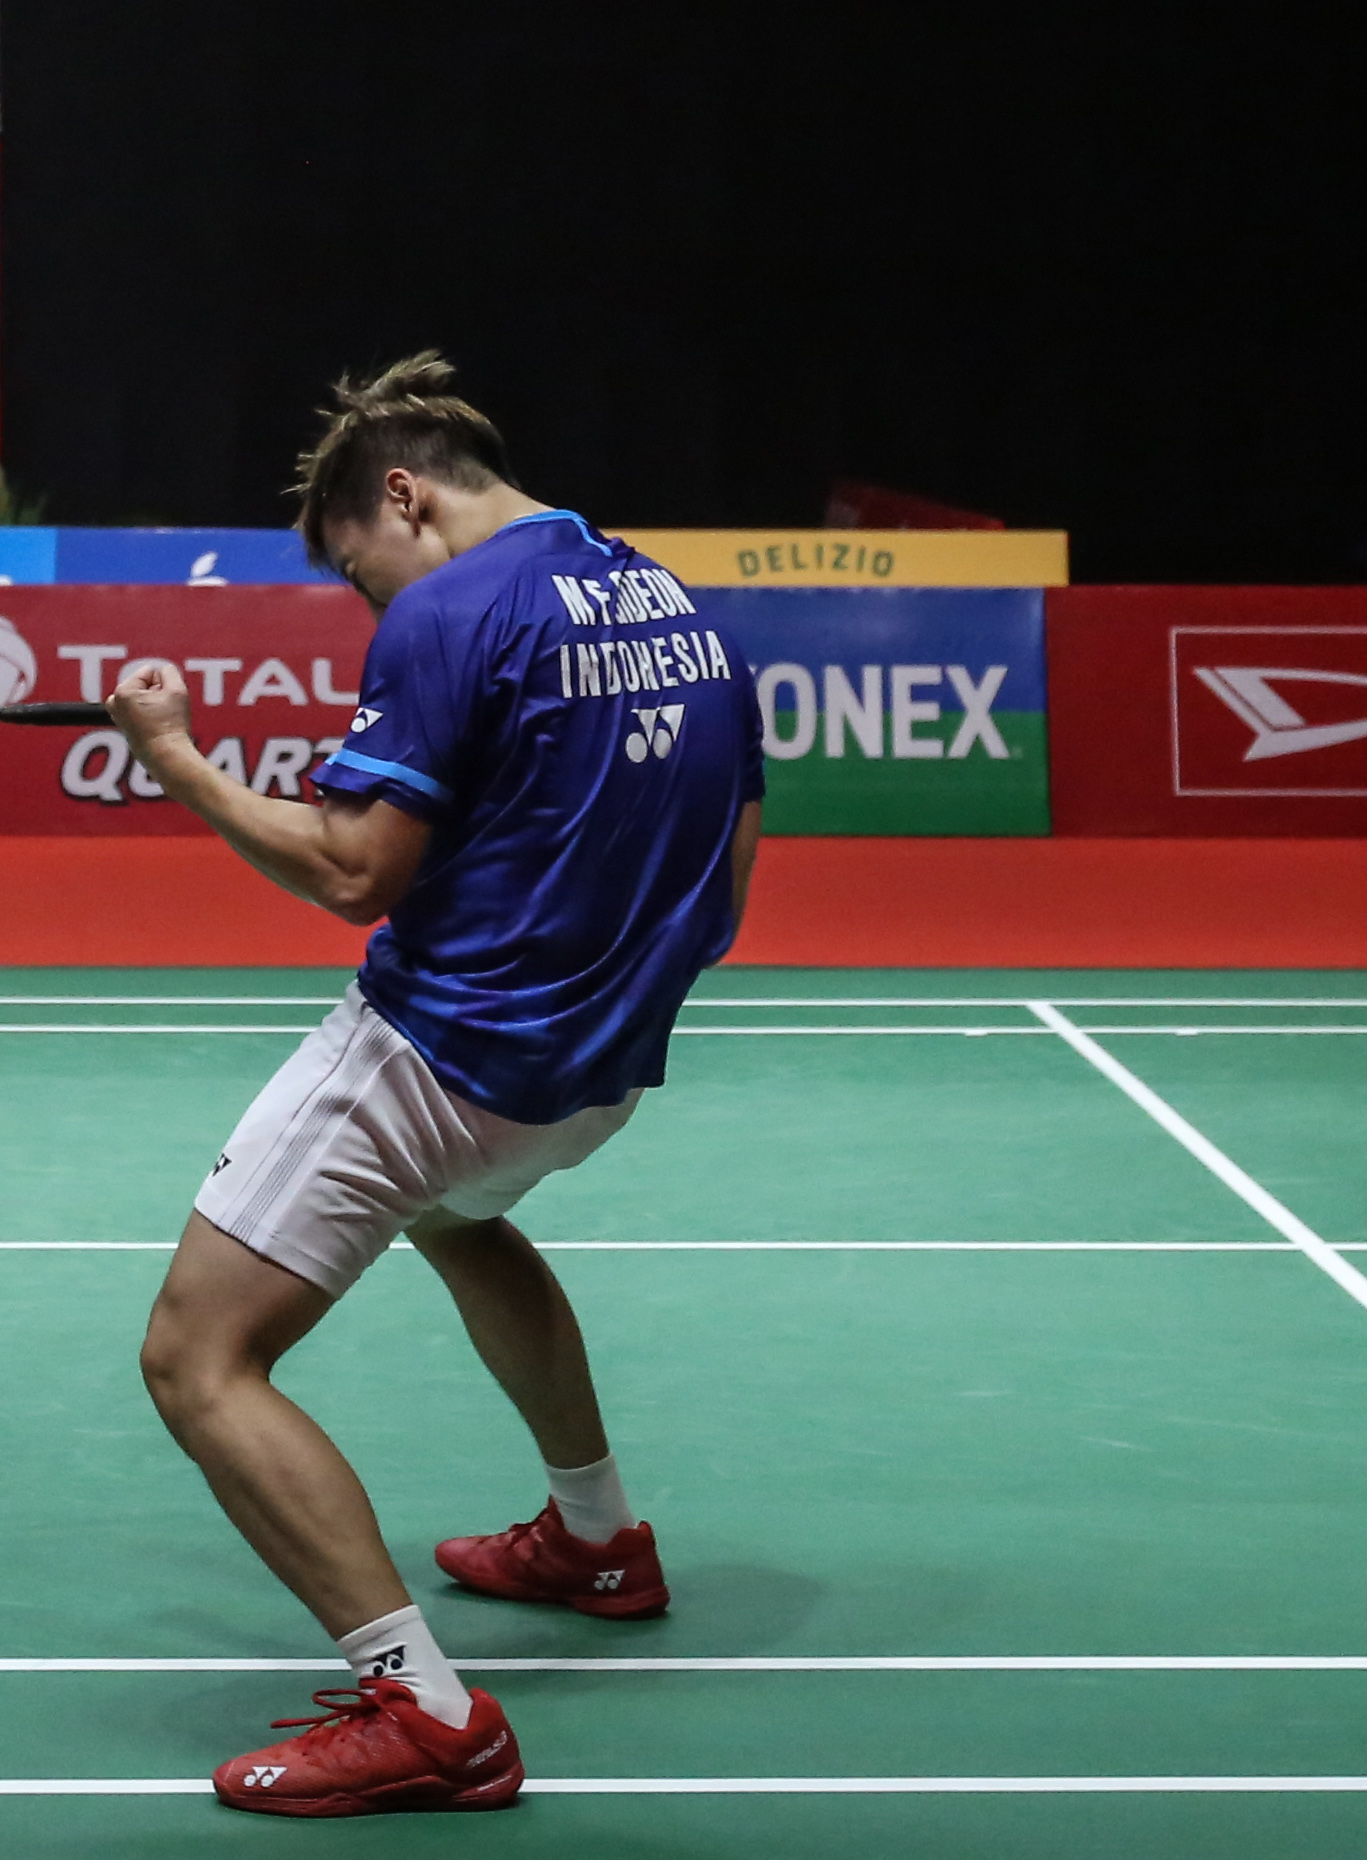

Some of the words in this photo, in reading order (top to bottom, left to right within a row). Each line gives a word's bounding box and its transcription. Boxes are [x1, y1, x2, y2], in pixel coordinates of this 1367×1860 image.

[738, 543, 896, 577] DELIZIO
[559, 630, 732, 698] INDONESIA
[748, 662, 1010, 760] ONEX
[60, 730, 345, 802] QAR
